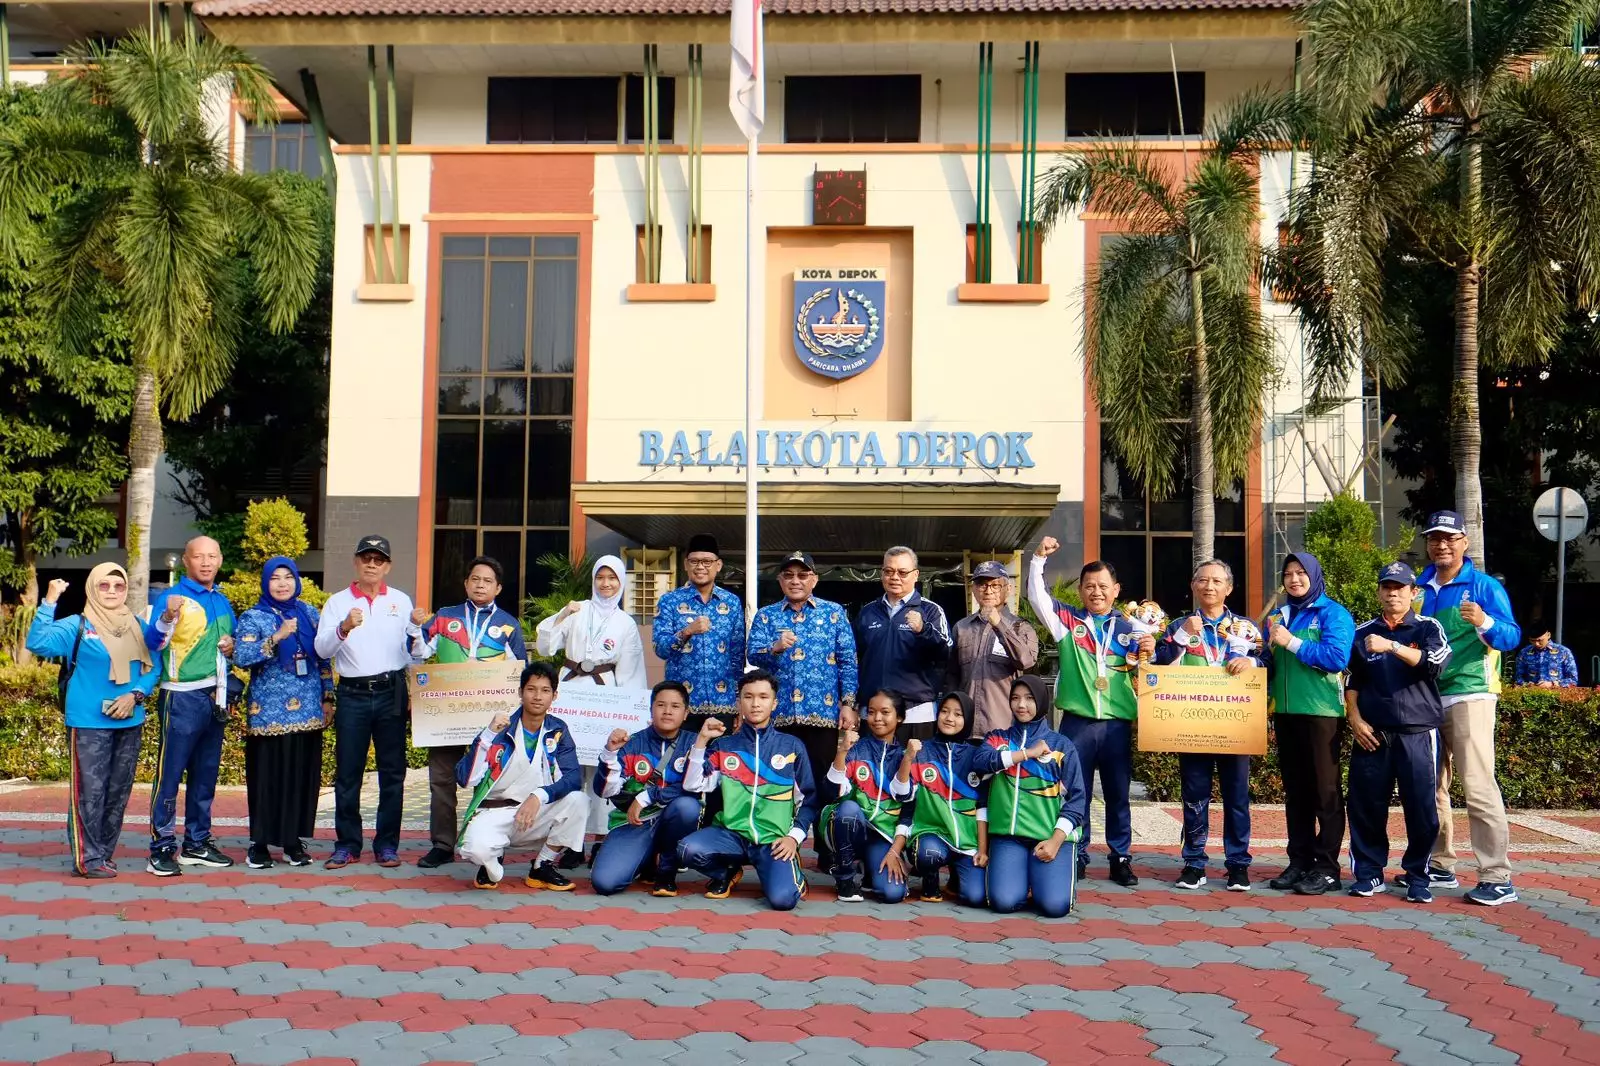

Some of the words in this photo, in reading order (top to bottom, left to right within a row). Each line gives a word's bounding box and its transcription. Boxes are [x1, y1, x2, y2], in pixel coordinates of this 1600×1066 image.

[802, 269, 832, 279] KOTA
[838, 269, 877, 279] DEPOK
[897, 431, 1036, 468] DEPOK
[477, 688, 516, 696] PERUNGGU
[1154, 693, 1187, 701] PERAIH
[1189, 694, 1223, 702] MEDALI
[1226, 695, 1251, 703] EMAS
[548, 707, 578, 716] PERAIH
[579, 710, 610, 719] MEDALI
[612, 713, 640, 722] PERAK
